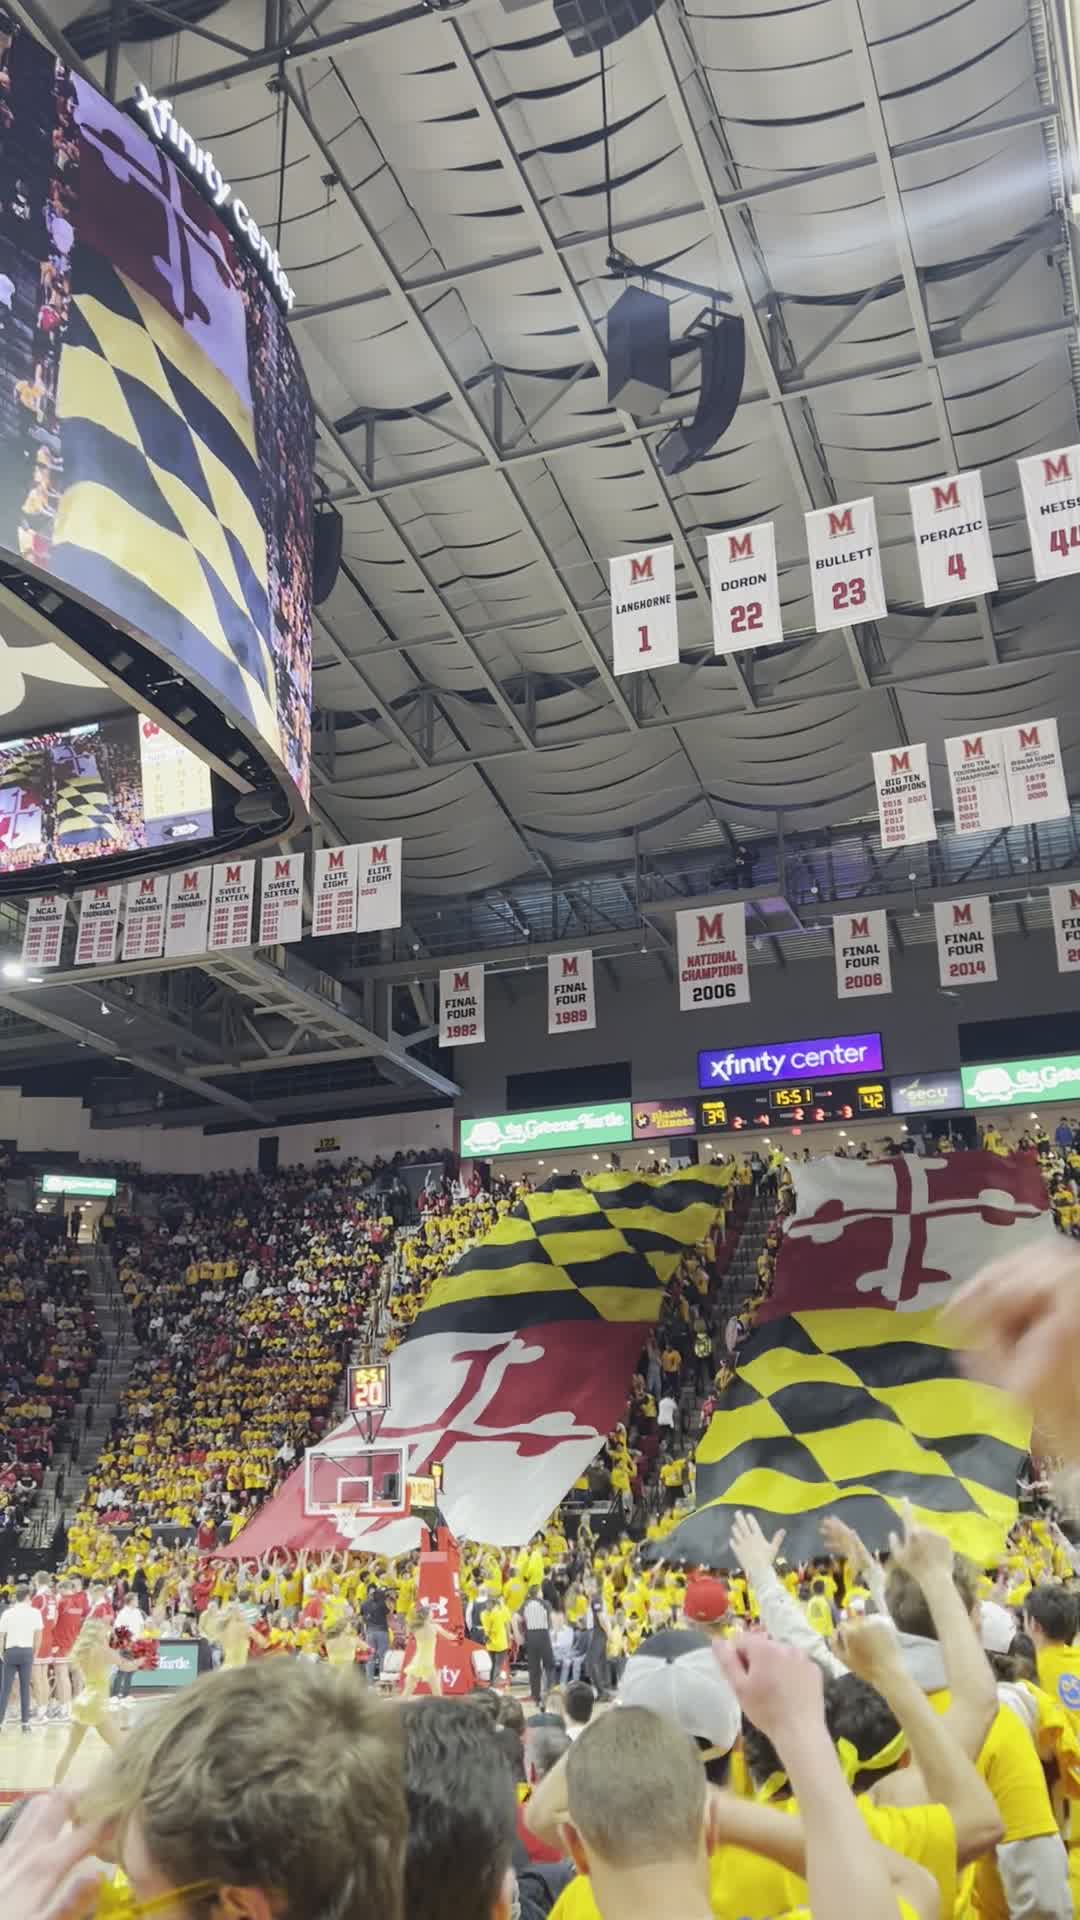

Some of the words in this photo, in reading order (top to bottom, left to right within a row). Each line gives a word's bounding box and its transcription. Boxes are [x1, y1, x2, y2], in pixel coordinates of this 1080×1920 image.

[920, 520, 984, 545] PERAZIC
[815, 547, 874, 570] BULLETT
[948, 552, 967, 581] 4
[721, 573, 767, 592] DORON
[831, 577, 867, 610] 23
[616, 593, 672, 615] LANGHORNE
[729, 601, 764, 633] 22
[638, 625, 652, 652] 1
[904, 774, 921, 783] TEN
[881, 781, 927, 796] CHAMPIONS
[324, 871, 349, 882] ELITE
[368, 865, 393, 876] ELITE
[268, 880, 296, 892] SWEET
[322, 880, 349, 890] EIGHT
[367, 873, 393, 885] EIGHT
[178, 893, 200, 902] NCAA
[219, 886, 247, 897] SWEET
[263, 888, 300, 900] SIXTEEN
[90, 902, 111, 911] NCAA
[136, 897, 157, 906] NCAA
[215, 894, 250, 905] SIXTEEN
[36, 907, 57, 916] NCAA
[944, 931, 985, 944] FINAL
[842, 944, 880, 957] FINAL
[948, 943, 984, 957] FOUR
[687, 950, 737, 968] NATIONAL
[846, 956, 880, 968] FOUR
[681, 963, 744, 983] CHAMPIONS
[949, 961, 986, 978] 2014
[554, 982, 588, 995] FINAL
[845, 973, 882, 990] 2006
[556, 993, 586, 1006] FOUR
[692, 983, 736, 1002] 2006
[445, 996, 478, 1009] FINAL
[447, 1007, 476, 1020] FOUR
[555, 1009, 588, 1024] 1989
[447, 1023, 477, 1039] 1982
[710, 1050, 786, 1081] xfinity
[789, 1043, 868, 1070] center
[863, 1094, 884, 1109] 42
[707, 1110, 727, 1126] 39
[355, 1382, 383, 1407] 20
